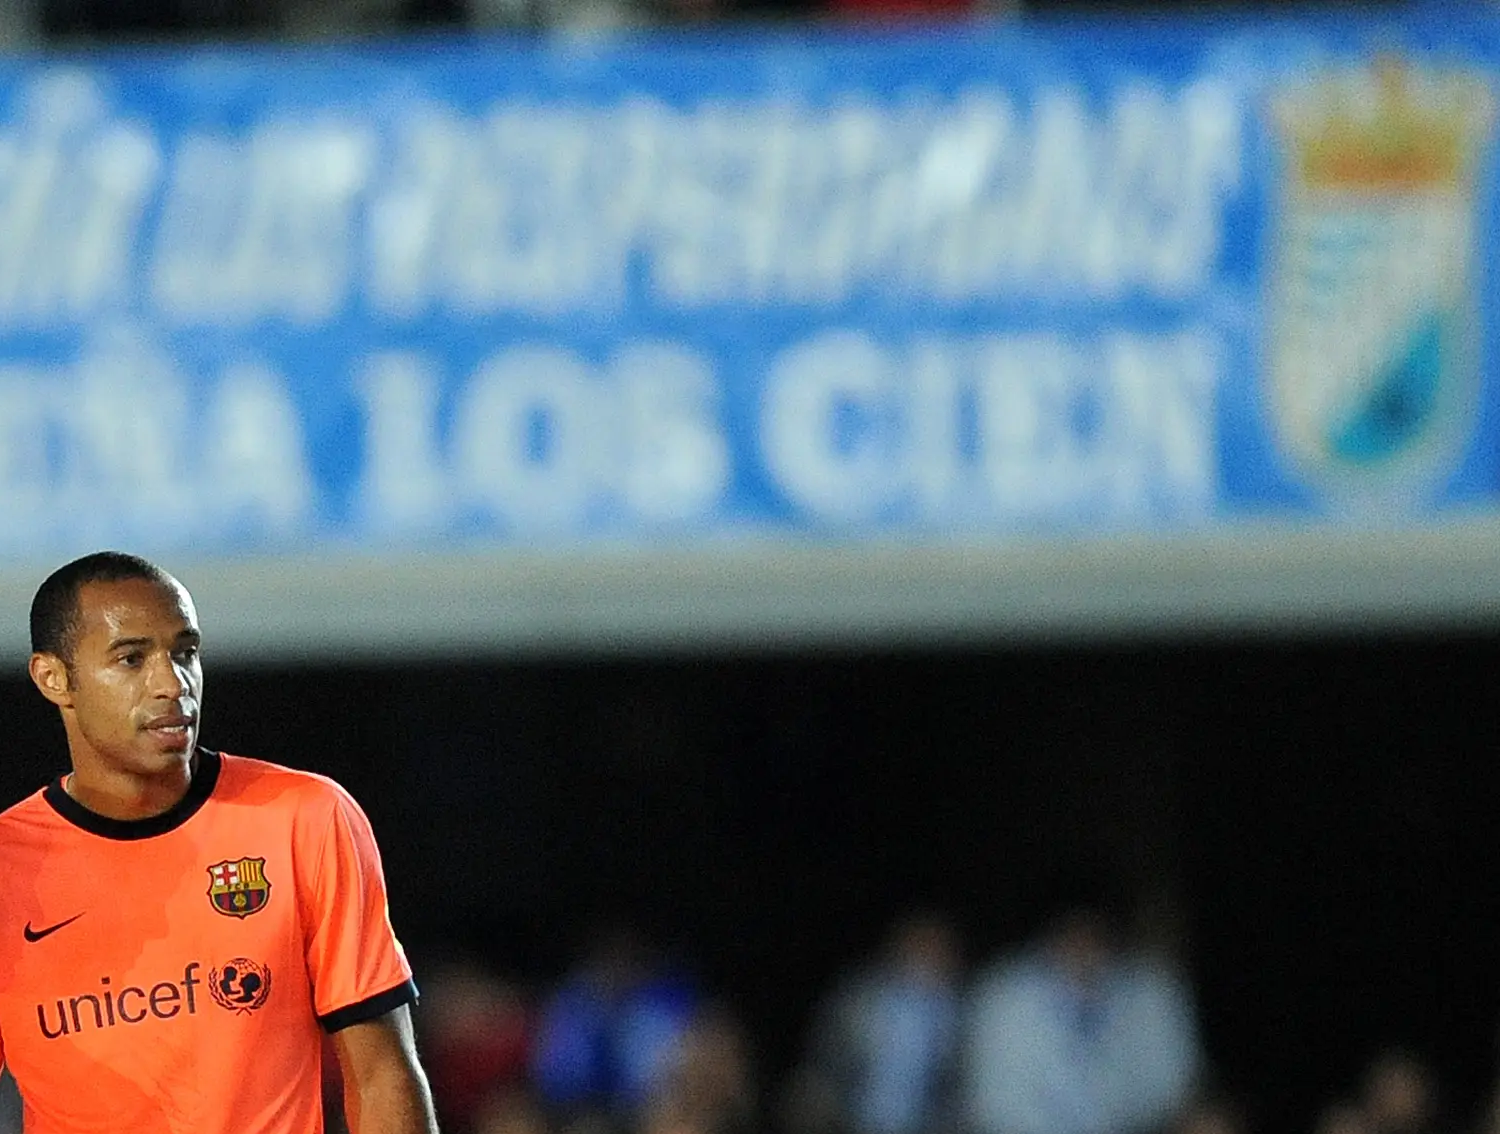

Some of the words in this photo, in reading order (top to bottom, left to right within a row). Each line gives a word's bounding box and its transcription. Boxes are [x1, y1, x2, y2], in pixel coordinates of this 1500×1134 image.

[343, 342, 736, 532] LOS
[758, 325, 1228, 528] CIEN
[37, 962, 201, 1039] unicef
